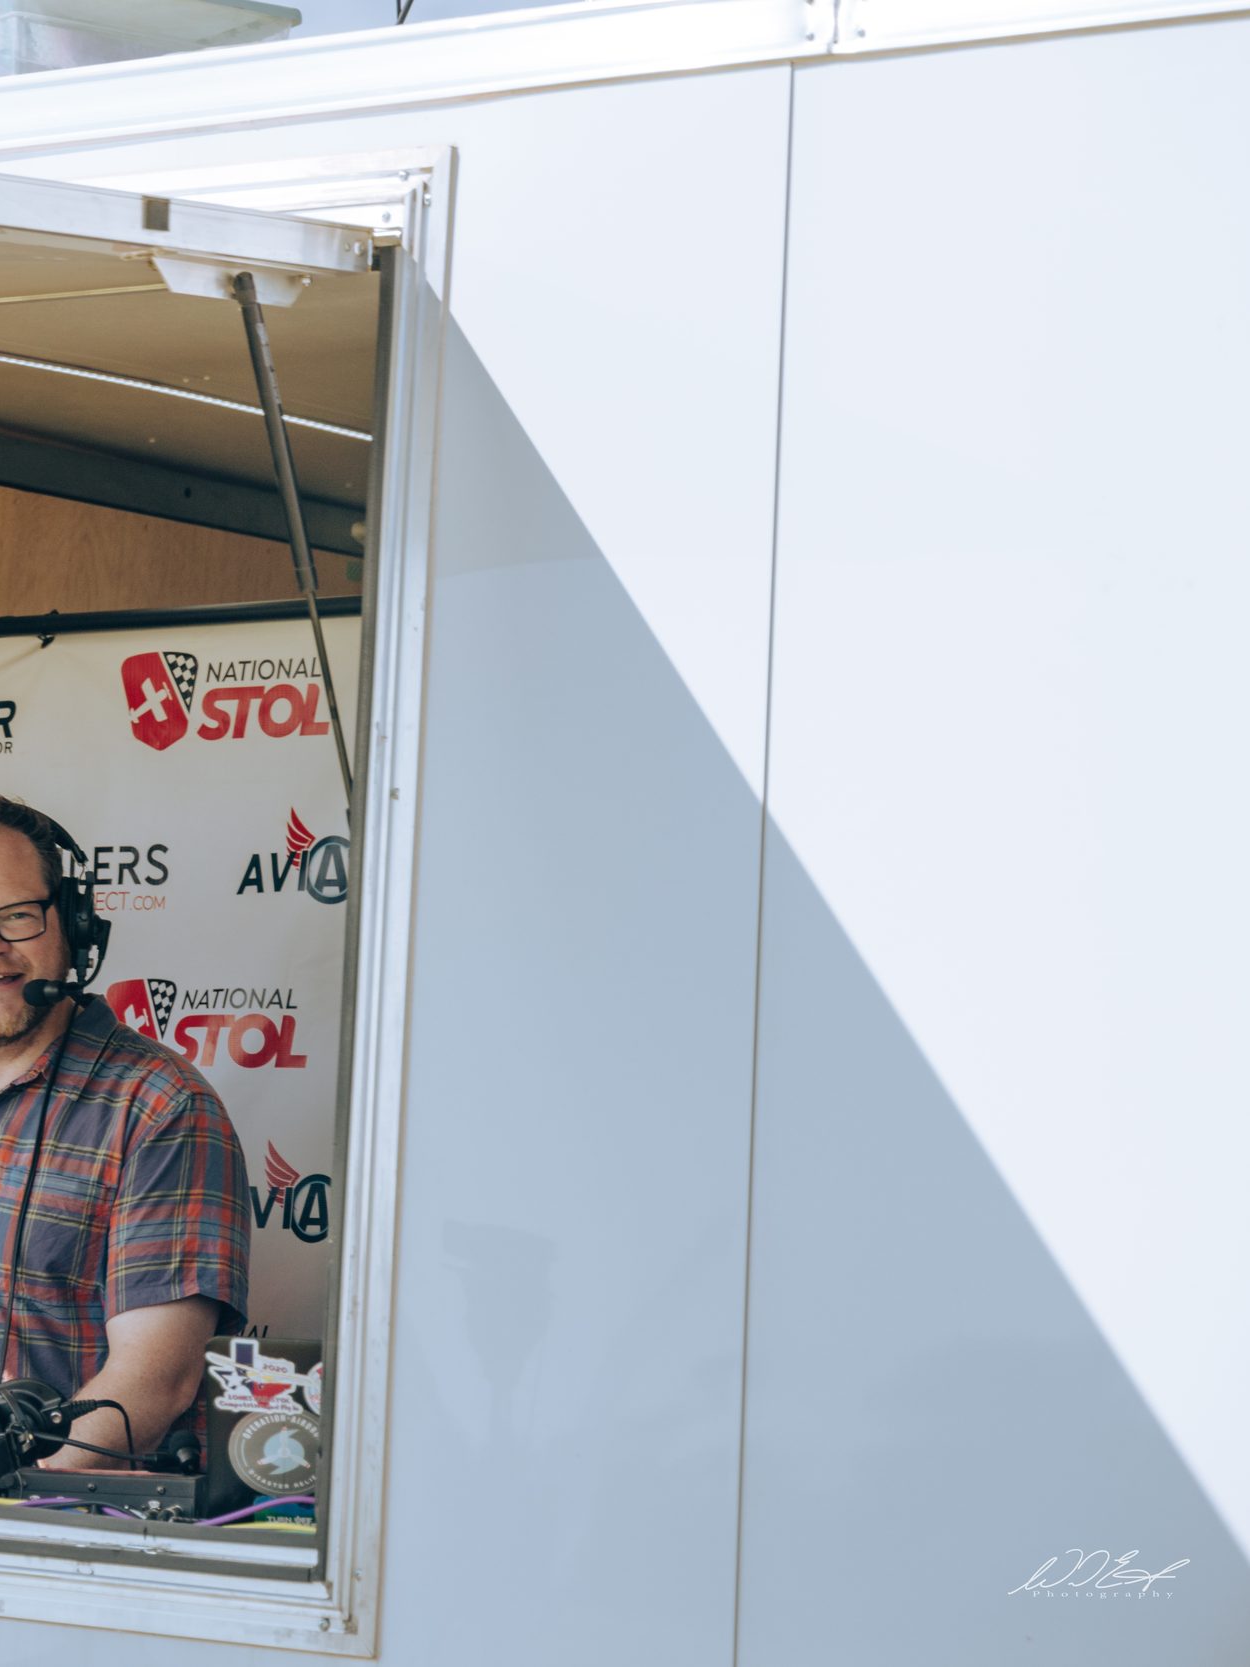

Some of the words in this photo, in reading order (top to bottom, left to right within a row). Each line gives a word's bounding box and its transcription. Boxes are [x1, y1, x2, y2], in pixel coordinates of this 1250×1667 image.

[206, 657, 322, 683] NATIONAL
[197, 683, 330, 740] STOL
[237, 838, 350, 901] AVIA
[94, 891, 167, 911] ECT.COM
[181, 987, 298, 1010] NATIONAL
[174, 1013, 308, 1068] STOL
[262, 1363, 288, 1374] 2020
[293, 1474, 317, 1489] RELIE
